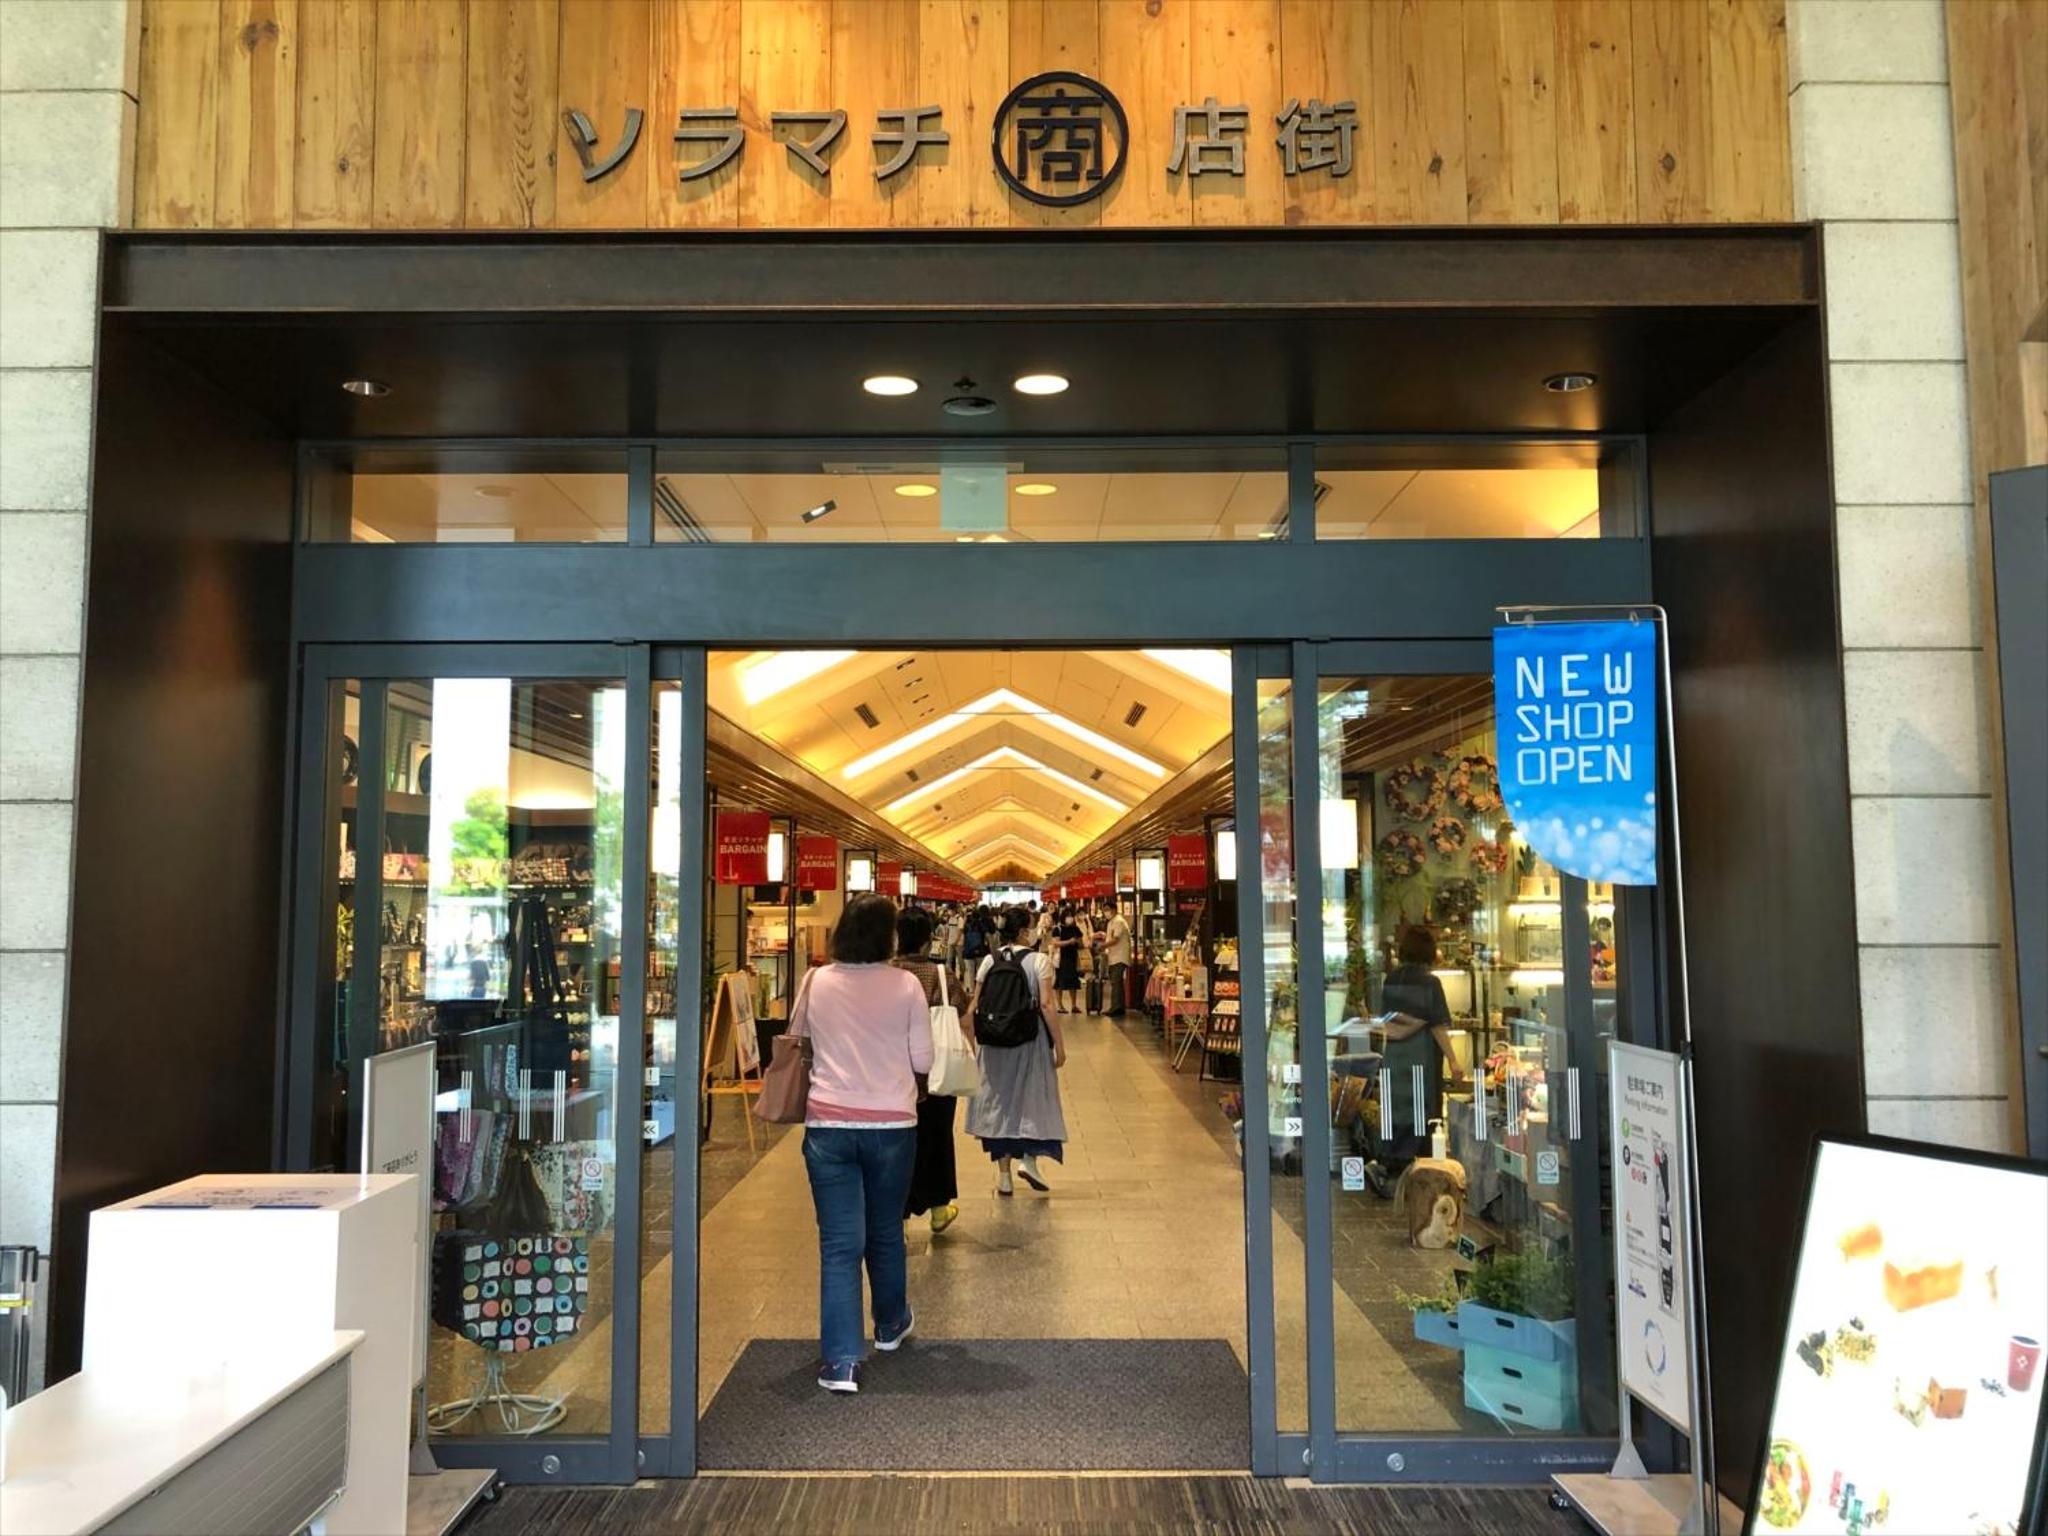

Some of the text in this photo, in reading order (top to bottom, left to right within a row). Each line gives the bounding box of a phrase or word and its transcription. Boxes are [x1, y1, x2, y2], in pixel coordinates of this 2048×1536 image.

[563, 71, 1361, 206] ソラマチ商店街
[1515, 652, 1632, 699] NEW
[1516, 700, 1634, 743] SHOP
[1517, 744, 1632, 785] OPEN
[720, 844, 768, 854] BARGAIN
